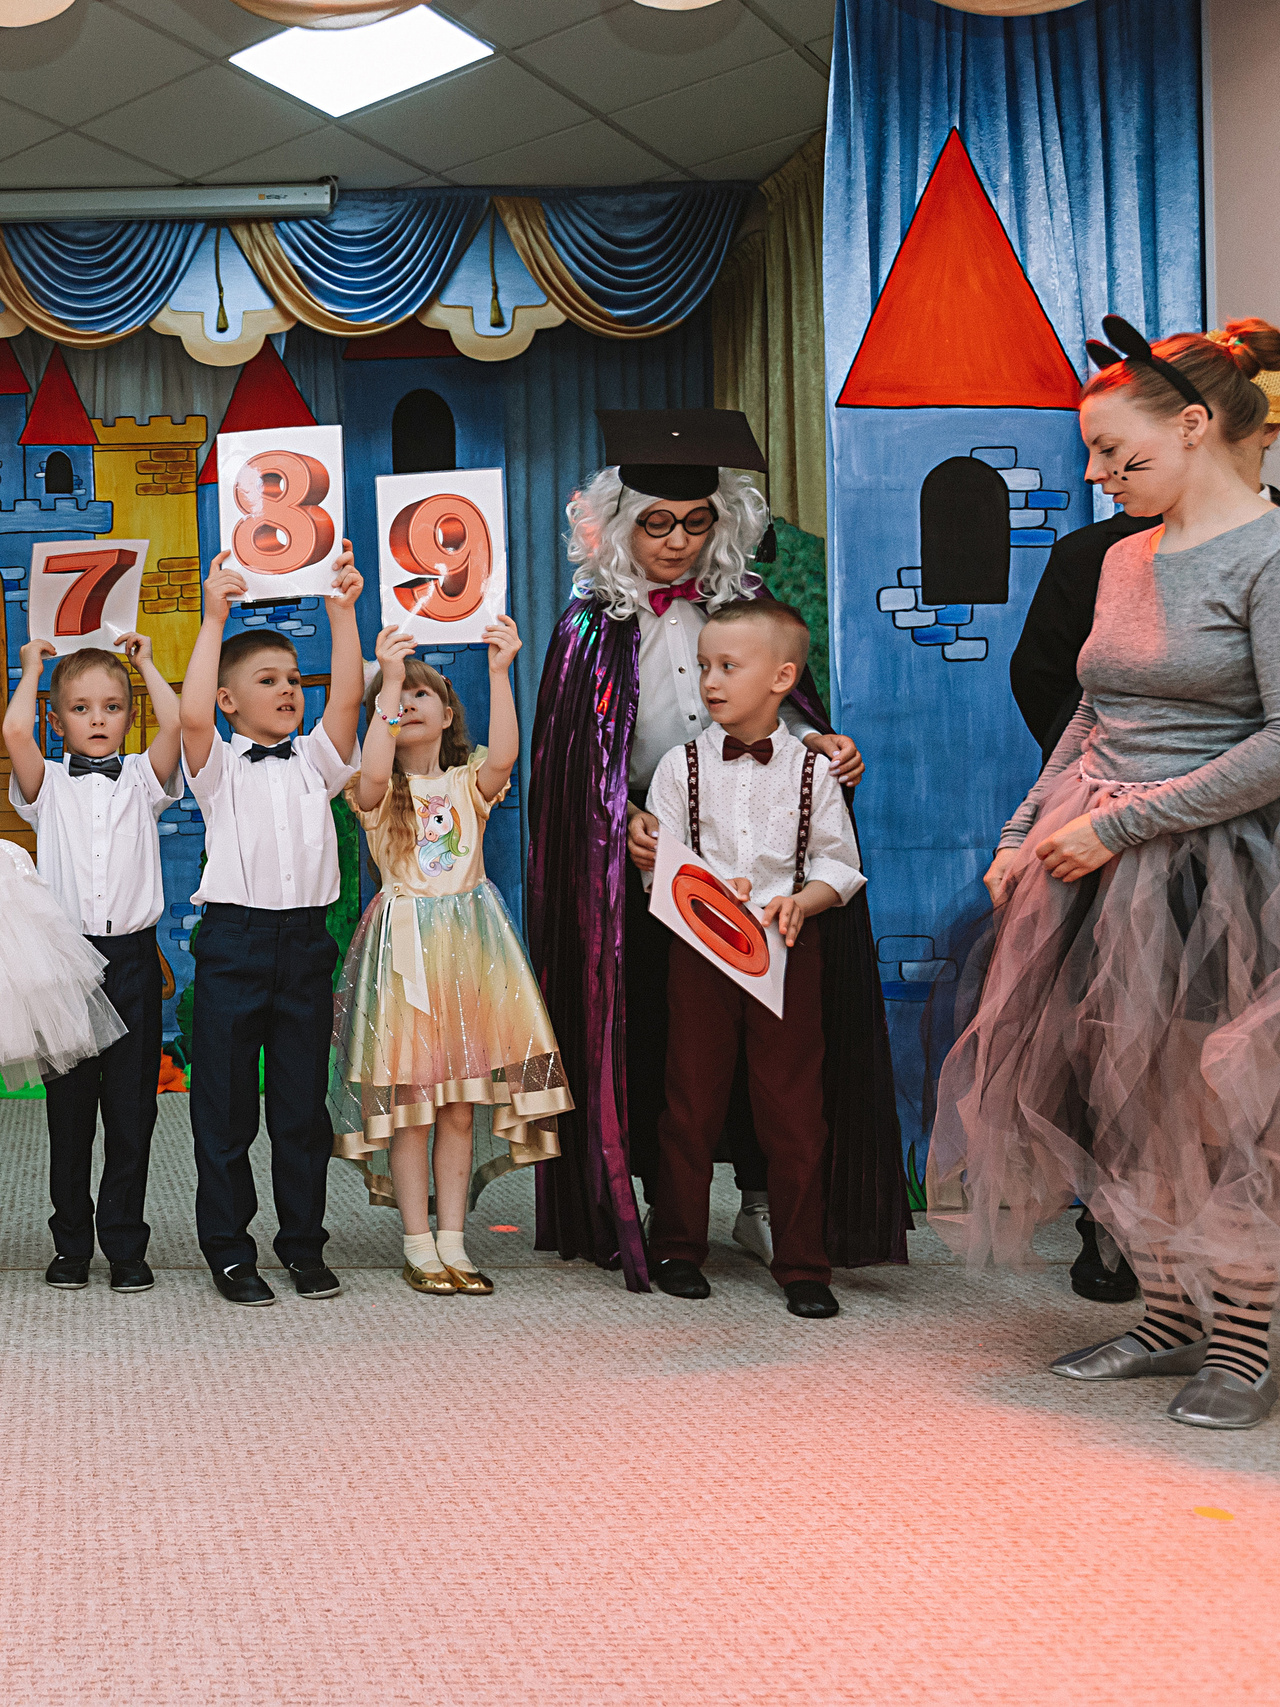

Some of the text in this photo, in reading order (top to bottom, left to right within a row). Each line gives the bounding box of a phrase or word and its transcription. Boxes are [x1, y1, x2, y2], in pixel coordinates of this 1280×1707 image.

[232, 450, 336, 575] 8
[389, 493, 493, 622] 9
[43, 548, 138, 637] 7
[671, 863, 770, 978] 0
